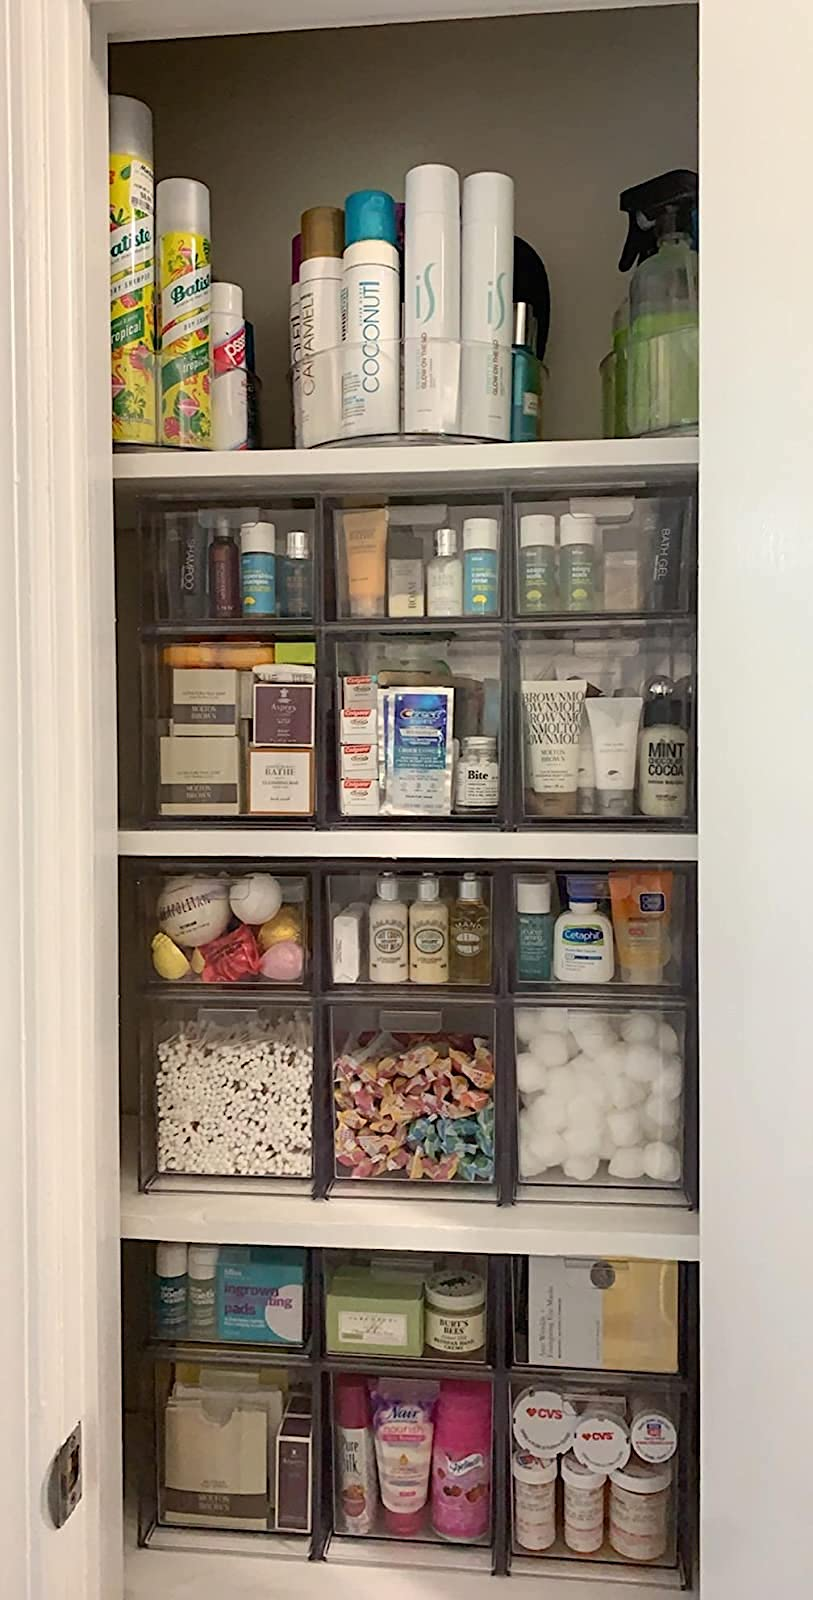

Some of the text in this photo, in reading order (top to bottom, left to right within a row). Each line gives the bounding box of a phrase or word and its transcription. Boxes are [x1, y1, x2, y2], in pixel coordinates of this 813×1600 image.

[110, 228, 152, 257] atiste
[648, 742, 686, 758] MINT
[468, 770, 489, 780] Bite
[648, 764, 685, 776] COCOA
[564, 930, 601, 943] Cetaphil
[224, 1283, 279, 1299] ingrown
[224, 1303, 257, 1316] pads
[443, 1327, 464, 1335] BEES
[385, 1406, 421, 1420] Nair
[538, 1408, 563, 1420] CVS
[592, 1432, 614, 1441] CVS
